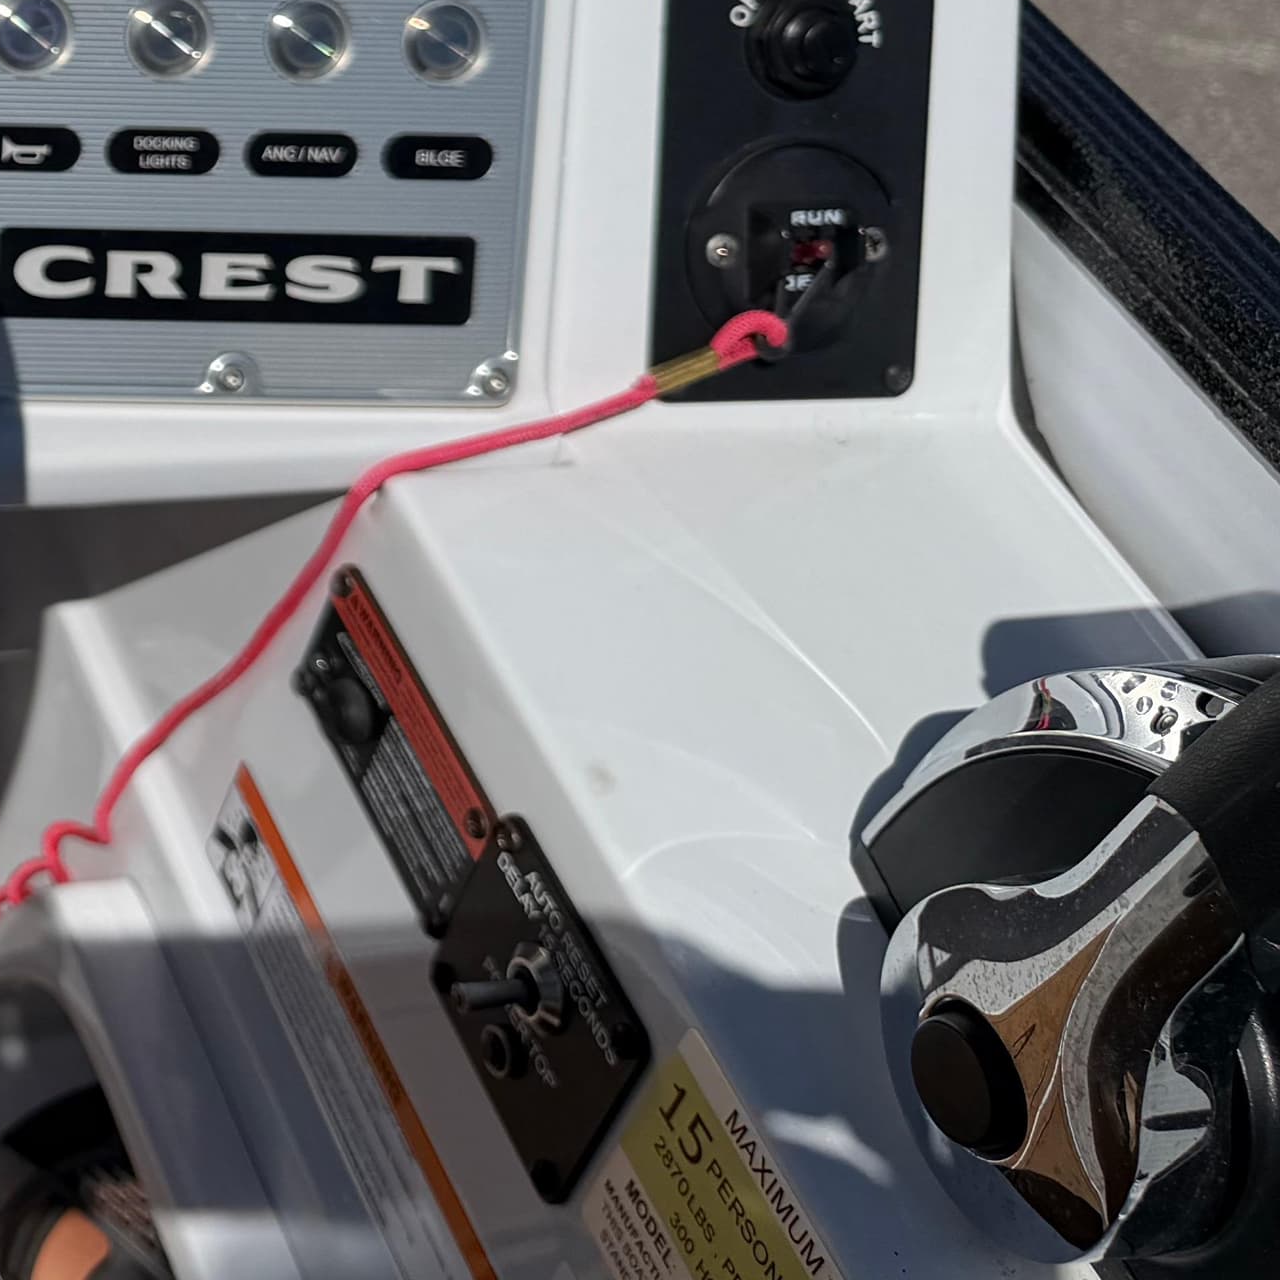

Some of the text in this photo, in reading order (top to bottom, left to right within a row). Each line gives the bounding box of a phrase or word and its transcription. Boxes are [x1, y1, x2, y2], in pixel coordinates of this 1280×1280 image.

[133, 135, 200, 152] DOCKING
[139, 153, 192, 170] LIGHTS
[415, 149, 466, 167] BILGE
[790, 208, 845, 226] RUN
[12, 244, 463, 304] CREST
[497, 851, 541, 920] DELAY
[554, 949, 618, 1066] SECONDS
[525, 871, 608, 1007] AUTO RESET
[658, 1082, 713, 1164] 15
[725, 1109, 825, 1275] MAXIMUM
[669, 1211, 695, 1255] 300
